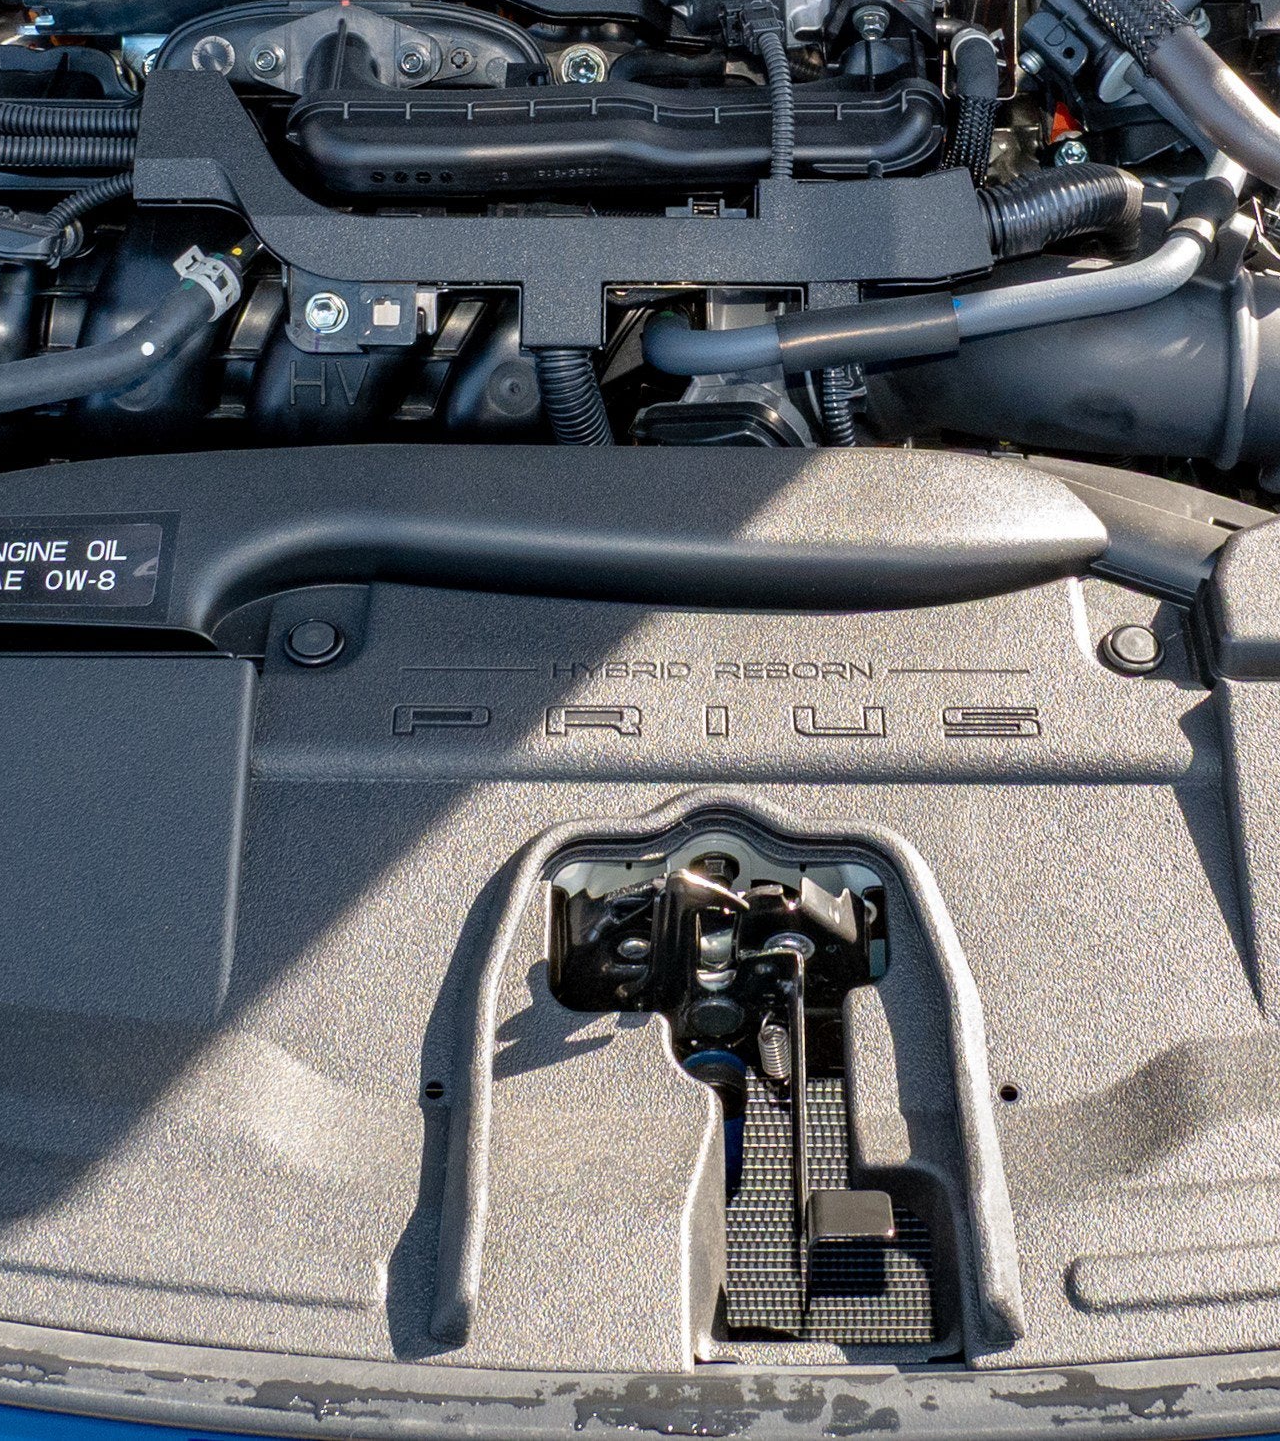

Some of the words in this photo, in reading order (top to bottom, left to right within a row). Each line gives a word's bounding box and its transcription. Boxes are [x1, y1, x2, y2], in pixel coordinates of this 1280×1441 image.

[289, 360, 370, 405] HV
[86, 539, 127, 561] OIL
[45, 569, 116, 591] 0W-8
[551, 661, 692, 680] HYBRID
[715, 661, 873, 680] REBORN
[392, 705, 1042, 739] PRIUS
